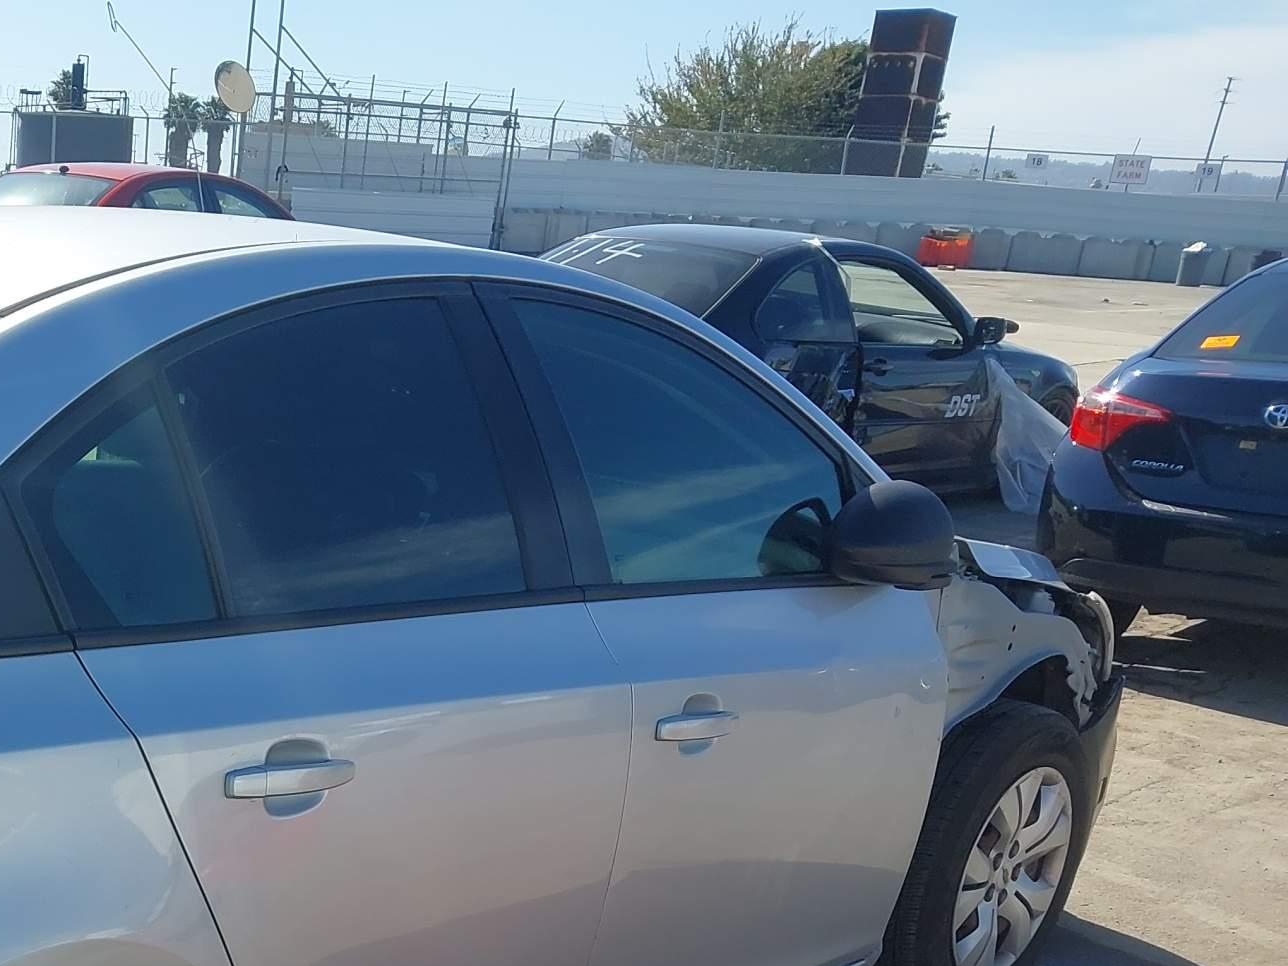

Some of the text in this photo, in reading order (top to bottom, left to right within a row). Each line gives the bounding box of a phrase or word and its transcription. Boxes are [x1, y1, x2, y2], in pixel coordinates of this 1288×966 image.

[1032, 157, 1043, 166] 18
[1118, 159, 1145, 169] STATE
[1116, 169, 1142, 180] FARM
[1202, 167, 1214, 176] 19
[944, 394, 981, 418] DST
